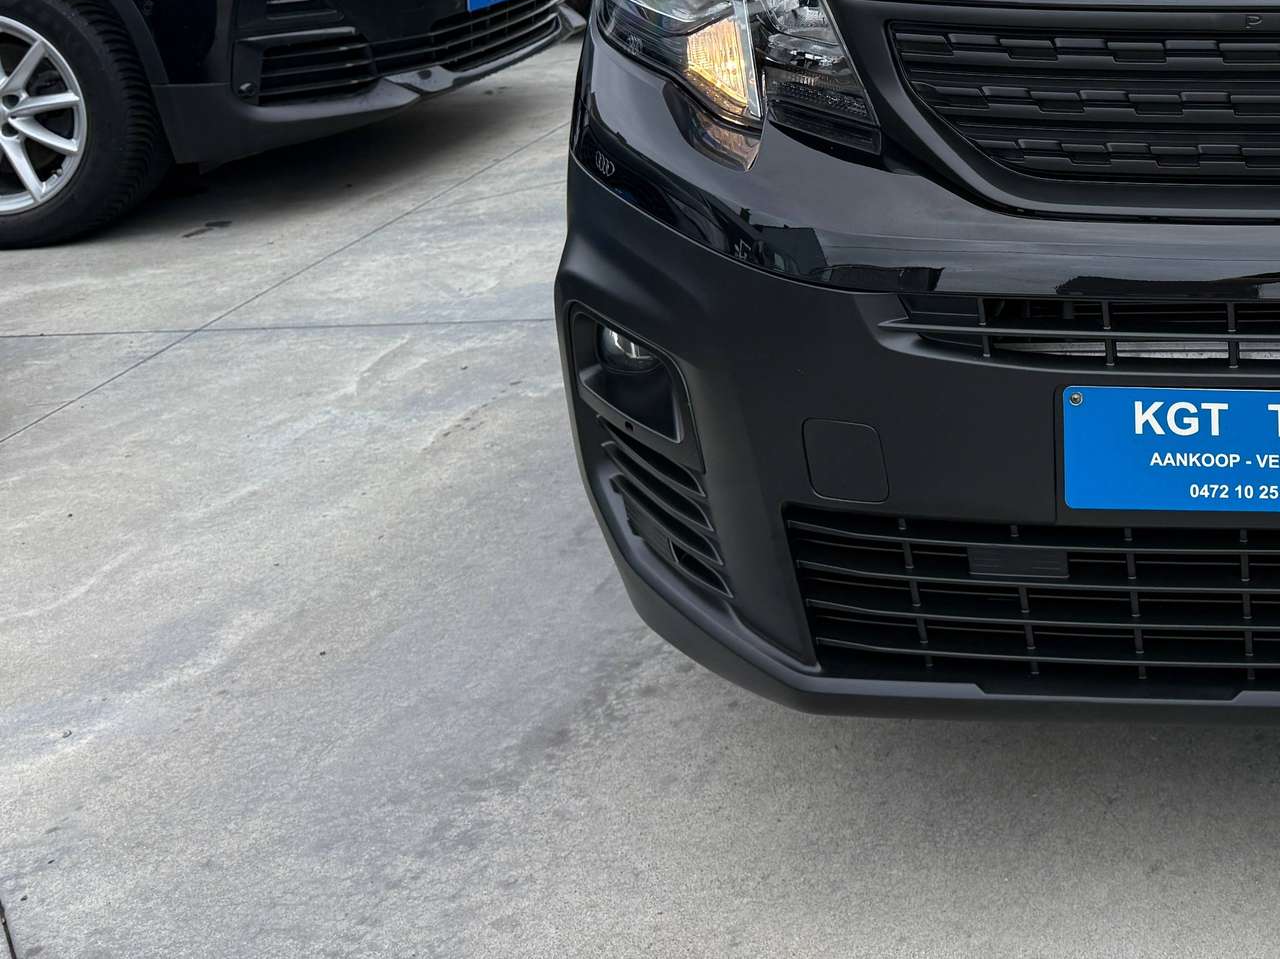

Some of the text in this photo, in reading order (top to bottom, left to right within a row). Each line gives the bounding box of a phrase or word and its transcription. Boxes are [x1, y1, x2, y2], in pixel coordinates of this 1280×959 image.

[1133, 400, 1229, 436] KGT
[1150, 452, 1241, 469] AANKOOP
[1189, 484, 1229, 499] 0472
[1235, 485, 1254, 499] 10
[1259, 485, 1279, 499] 25
